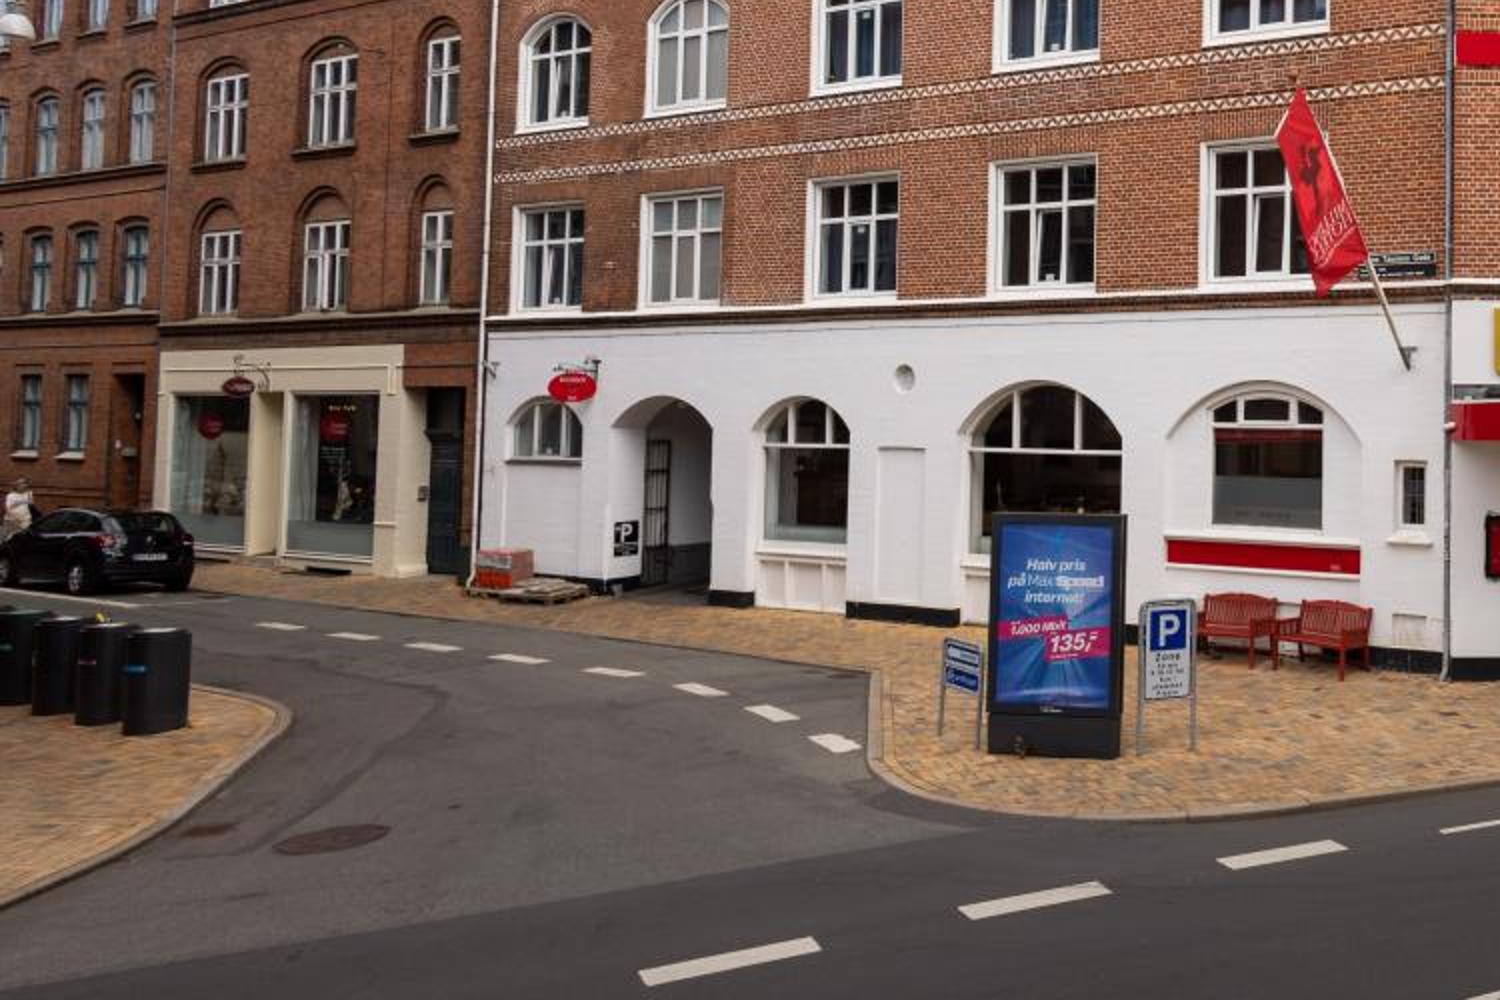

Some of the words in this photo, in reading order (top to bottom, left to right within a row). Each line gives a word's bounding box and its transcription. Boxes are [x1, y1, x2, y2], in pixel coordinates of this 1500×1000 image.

[621, 523, 633, 542] P
[1026, 558, 1058, 571] Halv
[1059, 558, 1087, 573] pris
[1007, 572, 1027, 589] på
[1158, 612, 1181, 648] P
